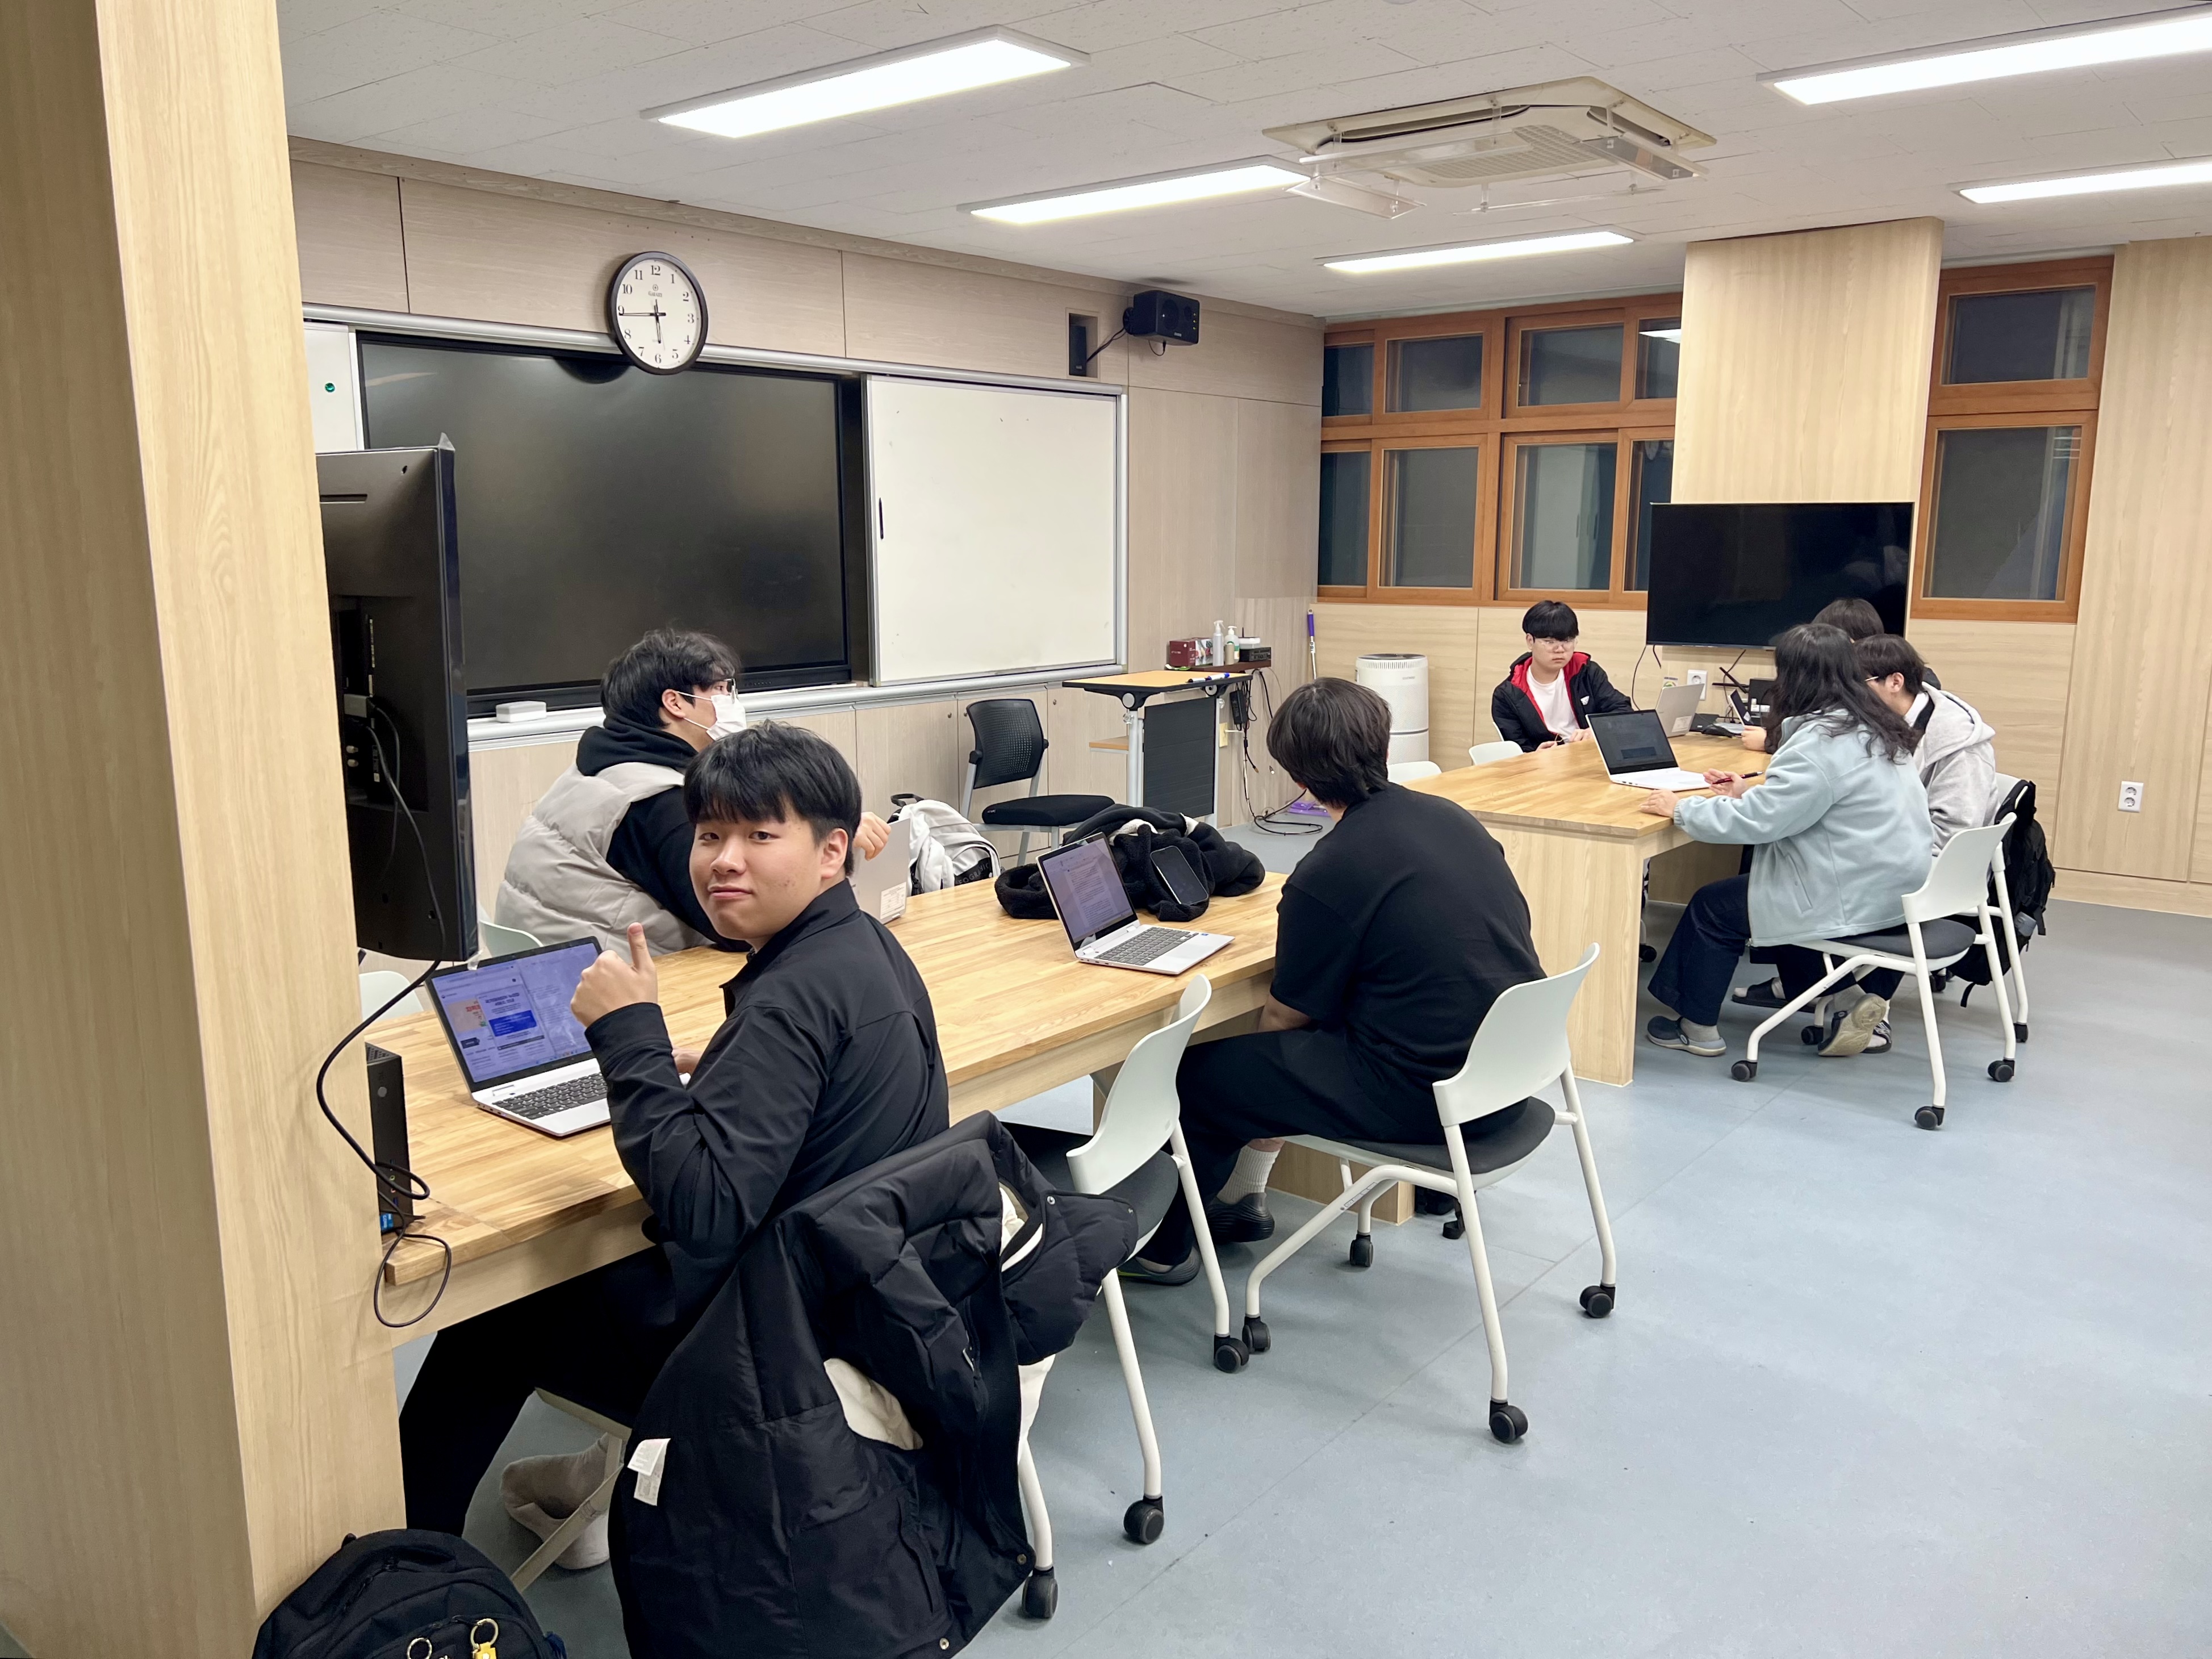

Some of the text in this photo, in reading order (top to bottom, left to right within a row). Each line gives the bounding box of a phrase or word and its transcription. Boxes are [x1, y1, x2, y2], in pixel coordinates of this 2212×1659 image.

[651, 265, 660, 275] 12
[635, 270, 643, 280] 11
[671, 274, 675, 283] 1
[622, 284, 632, 294] 10
[683, 292, 689, 301] 2
[618, 306, 624, 315] 9
[688, 314, 694, 323] 3
[625, 329, 631, 339] 8
[684, 335, 690, 344] 4
[639, 347, 644, 356] 7
[672, 349, 678, 359] 5
[655, 354, 661, 363] 6
